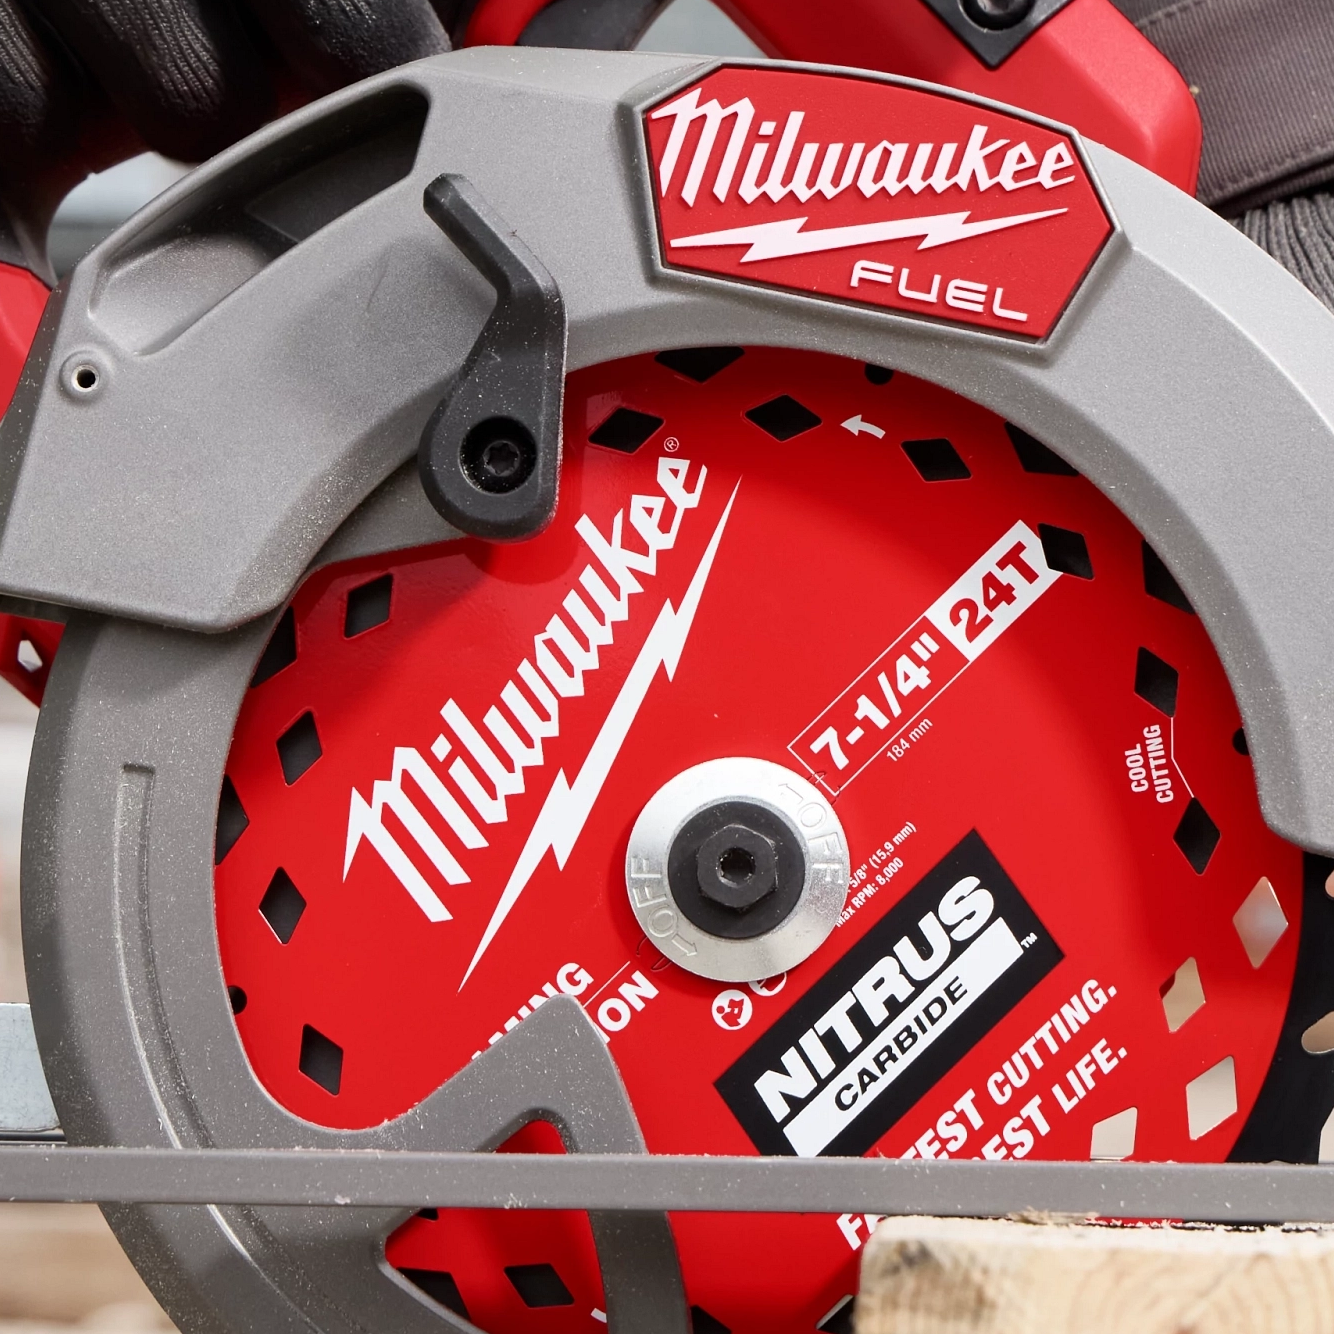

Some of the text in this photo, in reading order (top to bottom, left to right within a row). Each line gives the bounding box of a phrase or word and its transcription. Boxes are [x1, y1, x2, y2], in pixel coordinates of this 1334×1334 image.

[651, 87, 1076, 208] Milwaukee
[850, 260, 1028, 322] FUEL
[809, 540, 1040, 771] 7-1/4" 24T
[886, 718, 934, 762] 184 mm
[1124, 743, 1148, 793] COOL
[1142, 724, 1175, 804] CUTTING
[892, 821, 918, 846] mm)
[851, 882, 879, 908] RPM:
[875, 857, 905, 885] 8,000
[753, 875, 995, 1123] NITRUS
[833, 975, 969, 1113] CARBIDE
[987, 979, 1118, 1105] CUTTING.
[1052, 1038, 1128, 1113] LIFE.
